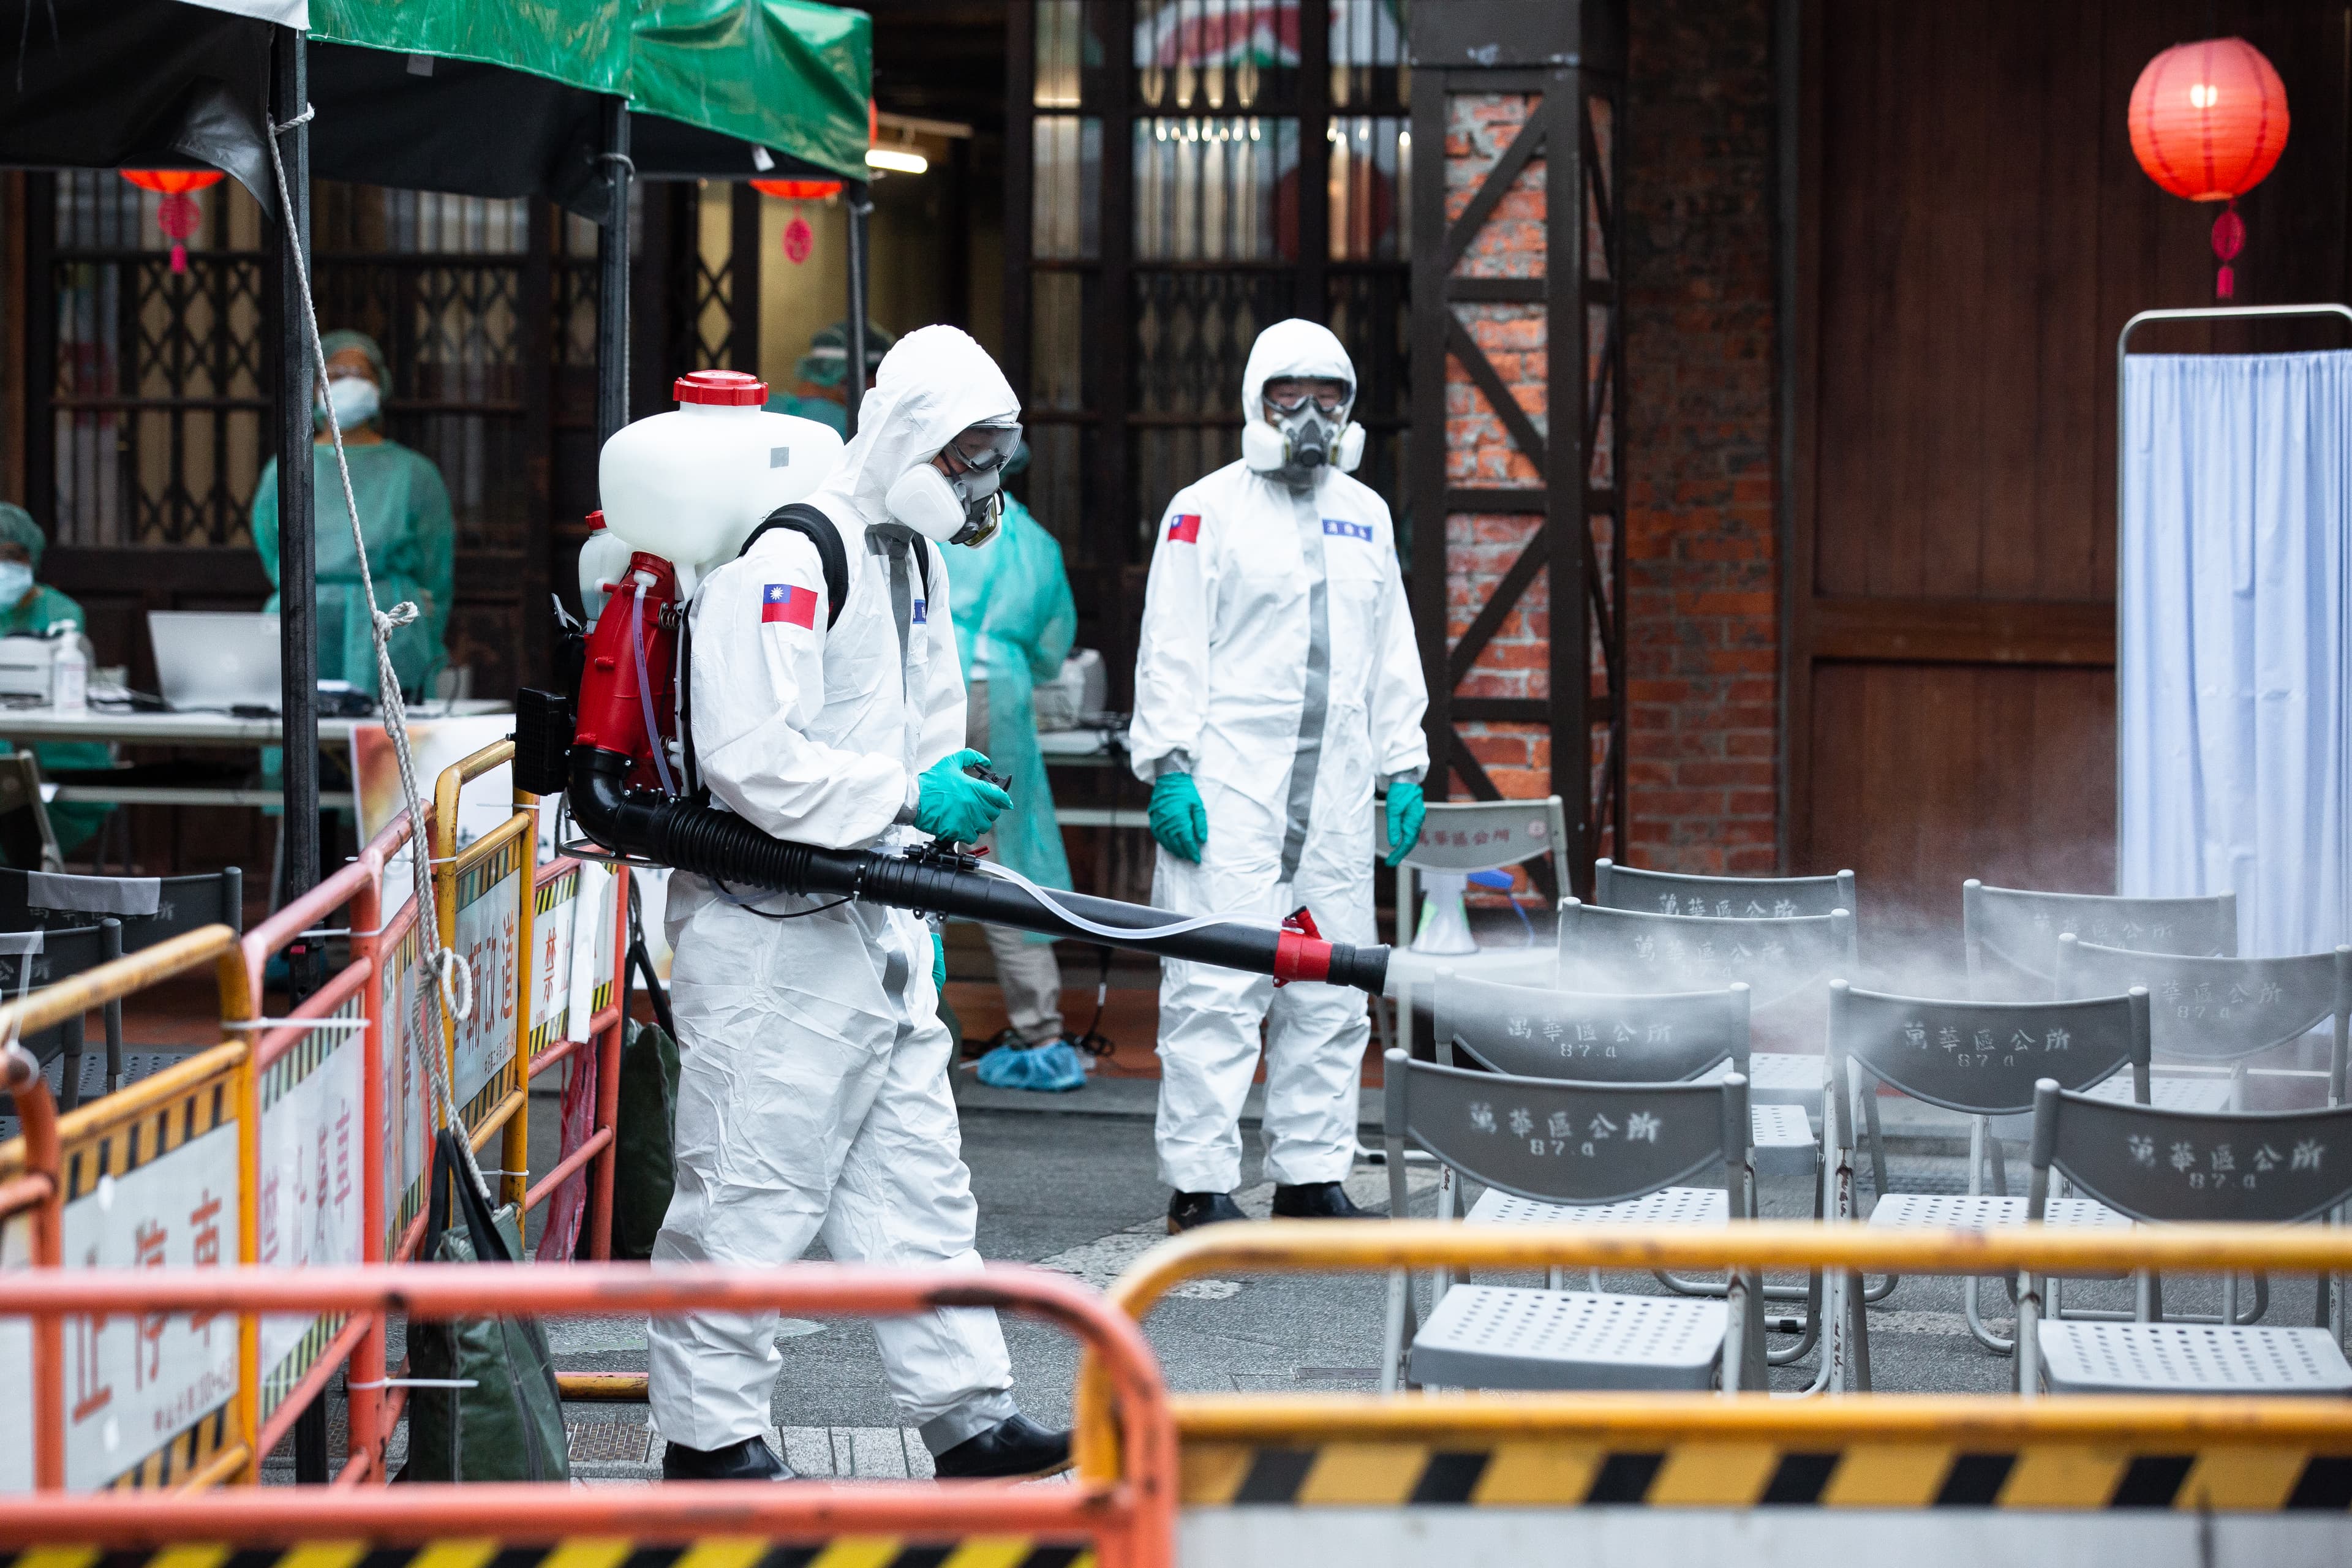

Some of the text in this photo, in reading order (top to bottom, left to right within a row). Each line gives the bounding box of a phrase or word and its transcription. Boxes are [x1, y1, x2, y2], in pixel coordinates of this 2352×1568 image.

[2132, 980, 2282, 1005] 華區公所
[1508, 1017, 1672, 1042] 萬華區公所
[1904, 1020, 2071, 1052] 萬華區公所
[1470, 1102, 1660, 1144] 萬華區公所
[2128, 1135, 2326, 1173] 萬華區公所
